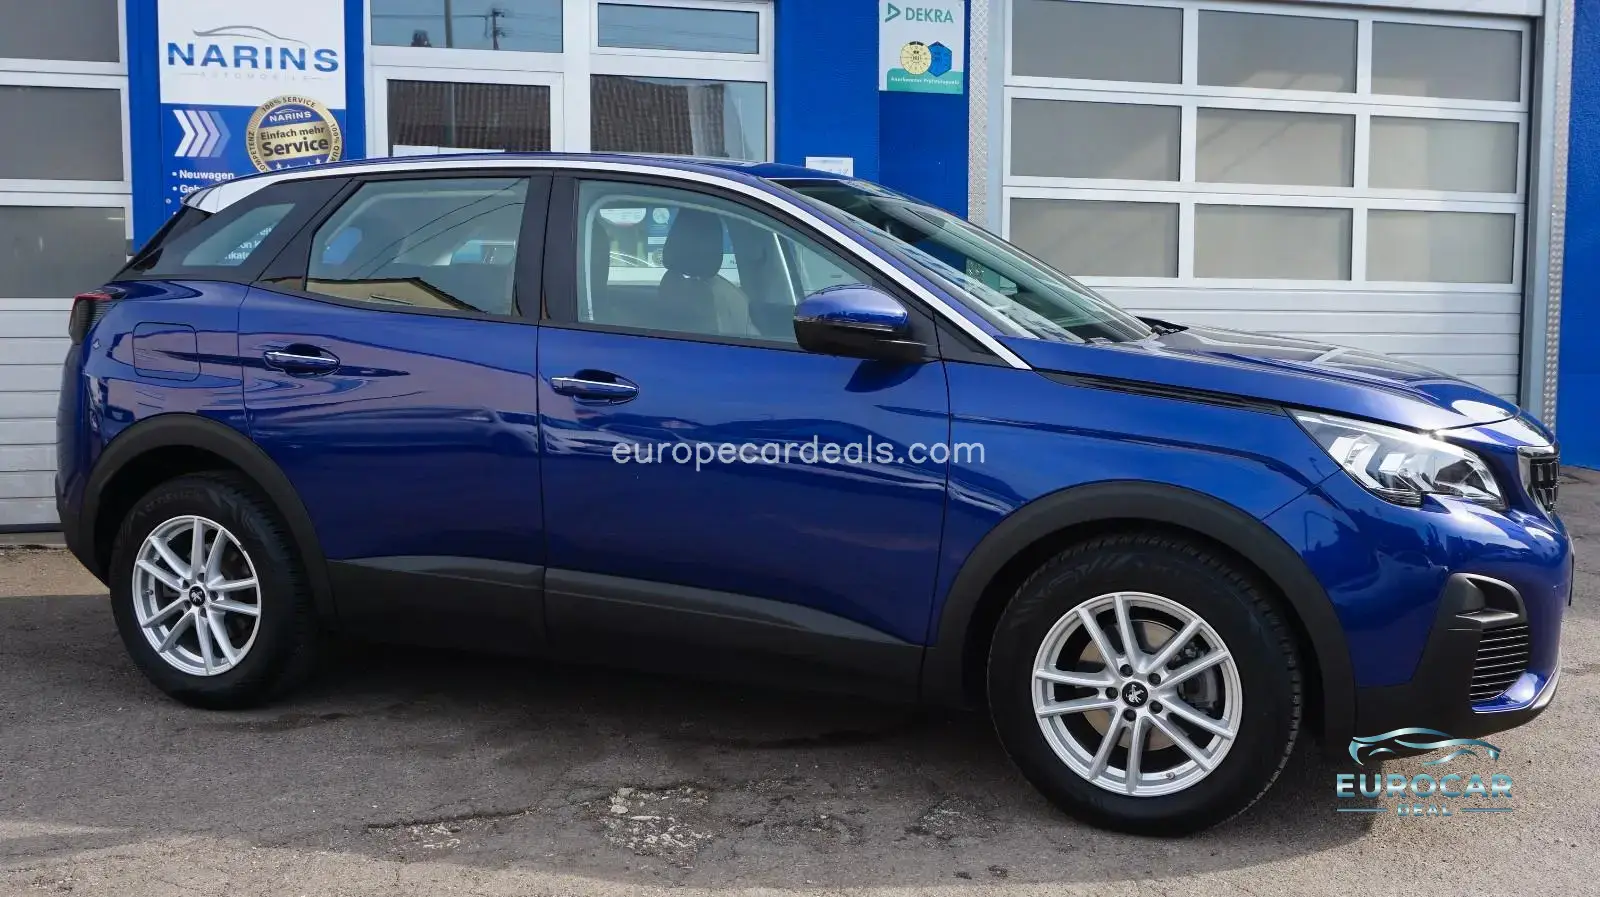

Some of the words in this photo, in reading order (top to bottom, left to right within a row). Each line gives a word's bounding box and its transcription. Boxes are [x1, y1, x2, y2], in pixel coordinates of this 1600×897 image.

[905, 7, 954, 23] DEKRA
[167, 42, 339, 73] NARINS
[282, 96, 317, 108] SERVICE
[269, 111, 312, 122] NARINS
[260, 129, 297, 141] Einfach
[299, 125, 325, 136] mehr
[247, 131, 268, 172] OMPETENZ
[261, 136, 329, 157] Service
[179, 169, 235, 181] Neuwagen
